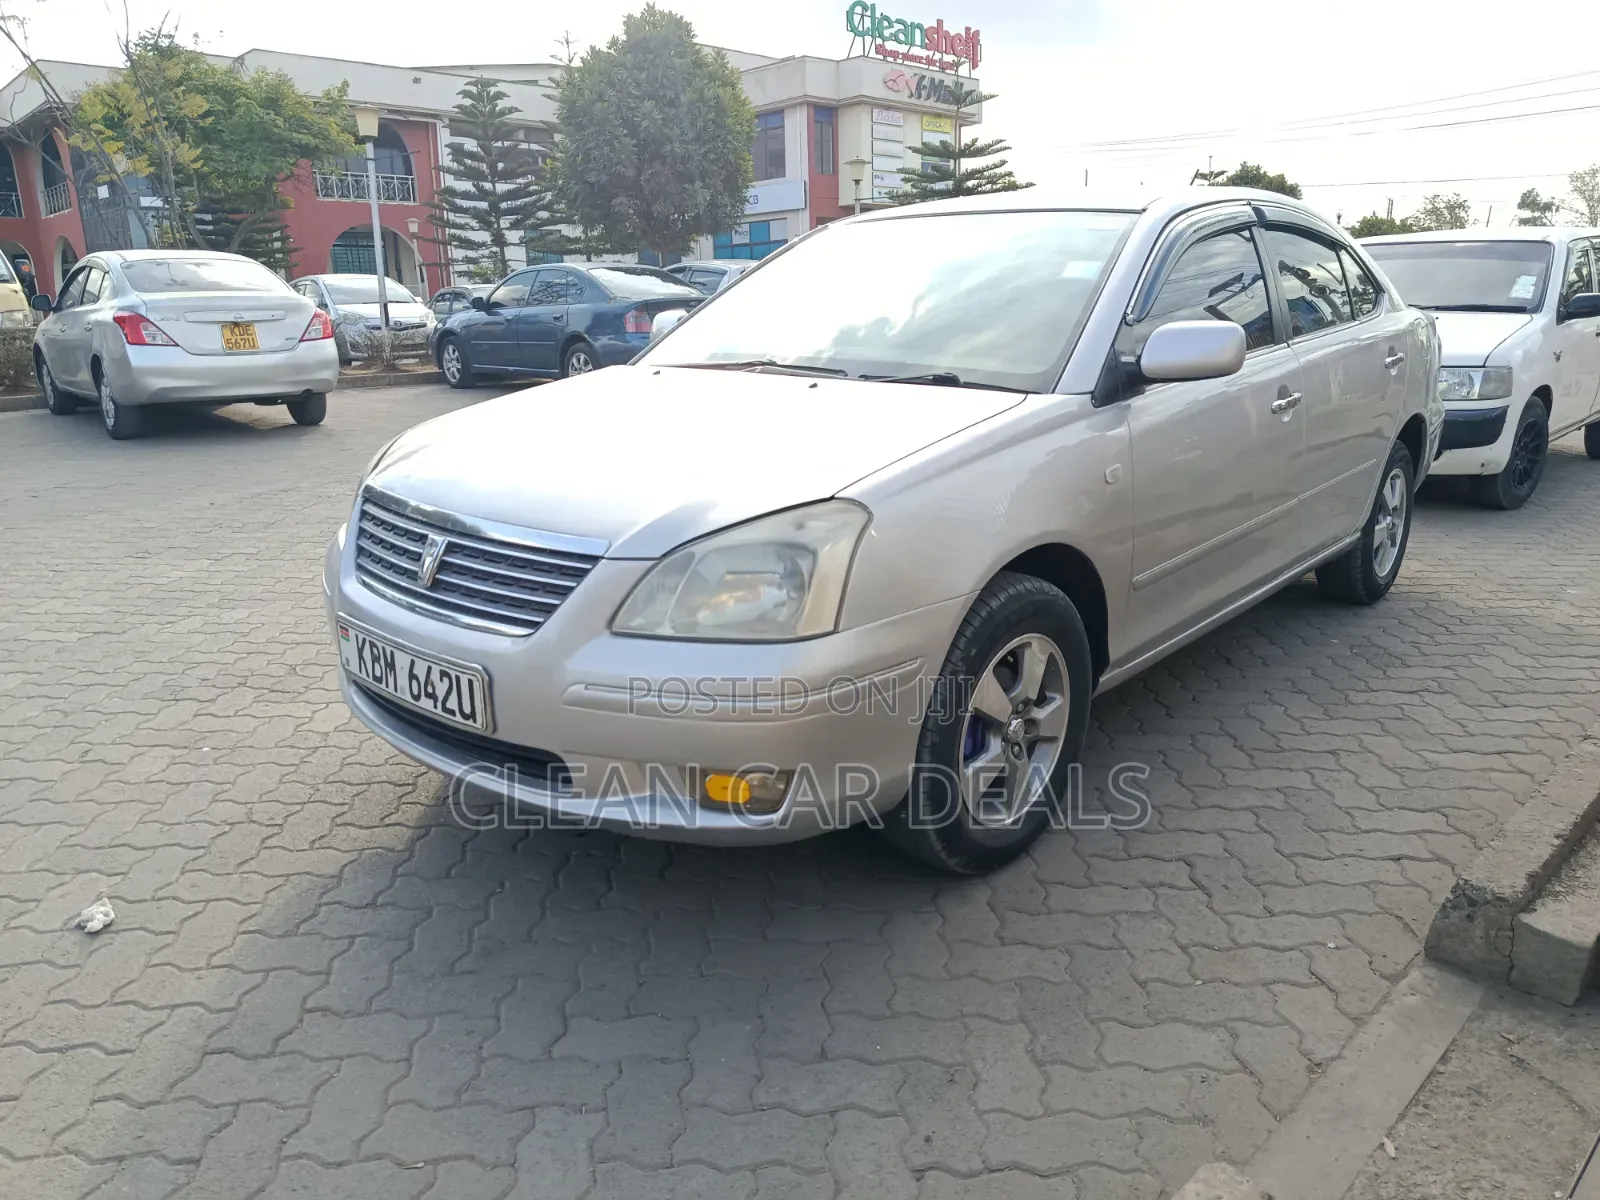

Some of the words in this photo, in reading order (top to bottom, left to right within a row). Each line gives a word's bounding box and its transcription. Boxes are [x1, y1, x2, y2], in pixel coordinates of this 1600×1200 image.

[230, 324, 253, 337] KDE
[226, 337, 256, 349] 567U
[355, 633, 398, 693] KBM
[408, 659, 478, 724] 642U
